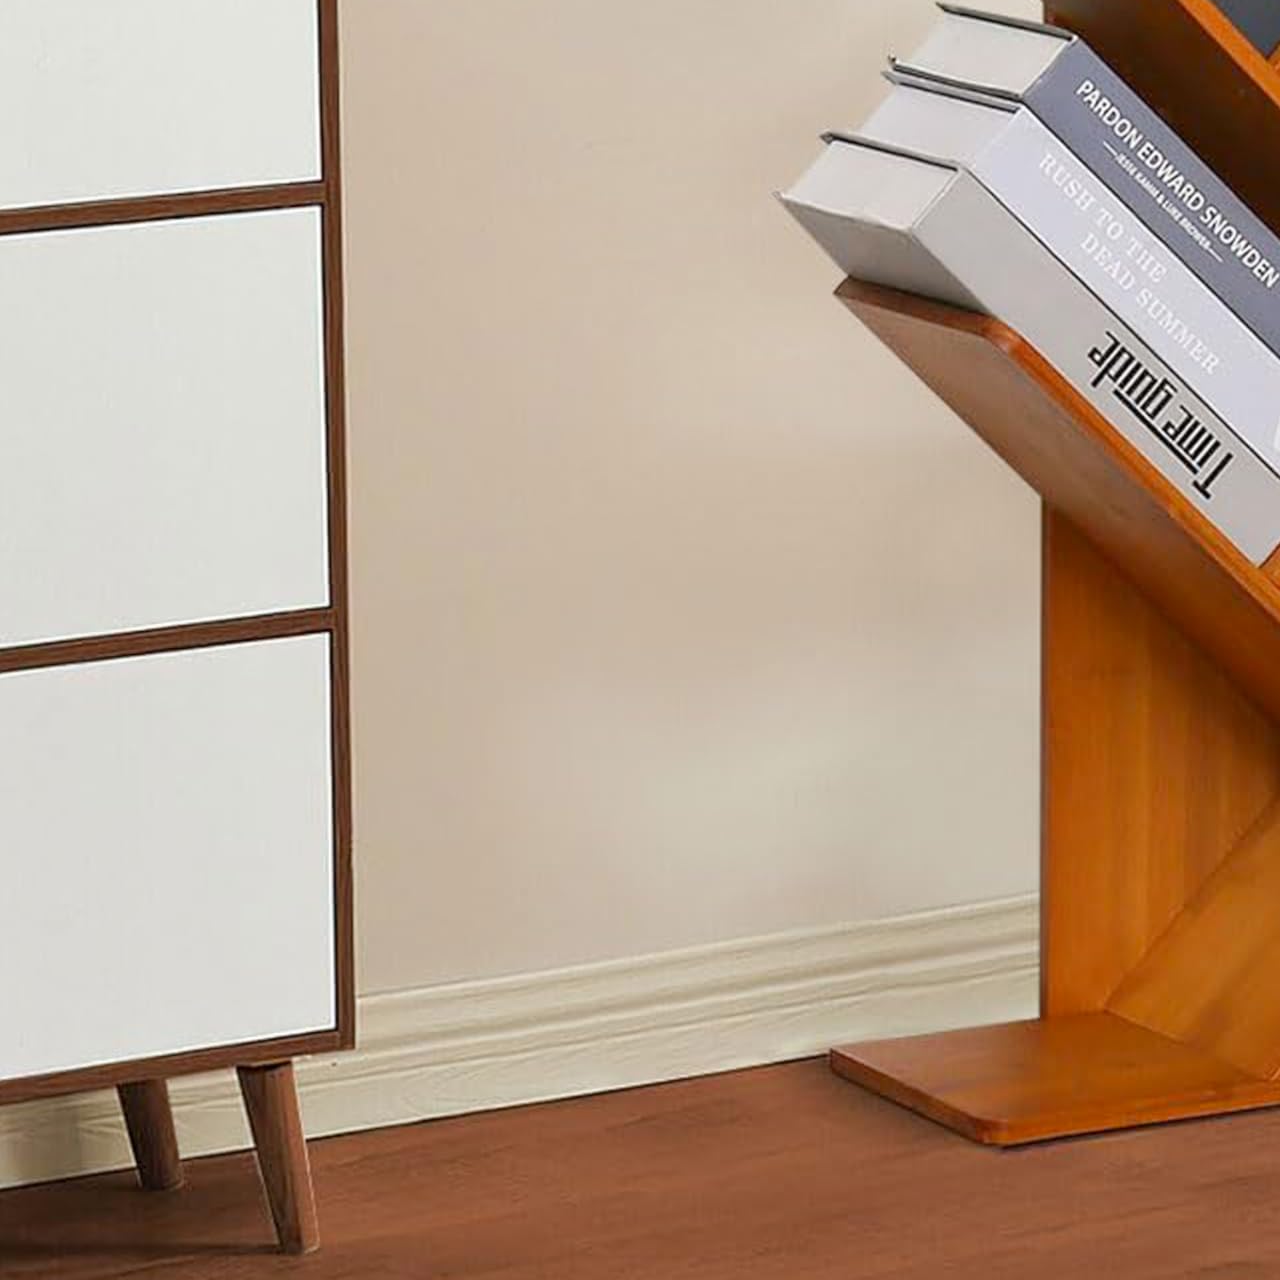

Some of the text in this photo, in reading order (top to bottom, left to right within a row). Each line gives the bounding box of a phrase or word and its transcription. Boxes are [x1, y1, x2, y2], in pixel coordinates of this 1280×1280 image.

[1037, 153, 1167, 283] RUSH TO THE
[1076, 79, 1280, 289] PARDON EDWARD SNOWDEN
[1079, 232, 1221, 376] DEAD SUMMER
[1087, 330, 1234, 500] Time guide
